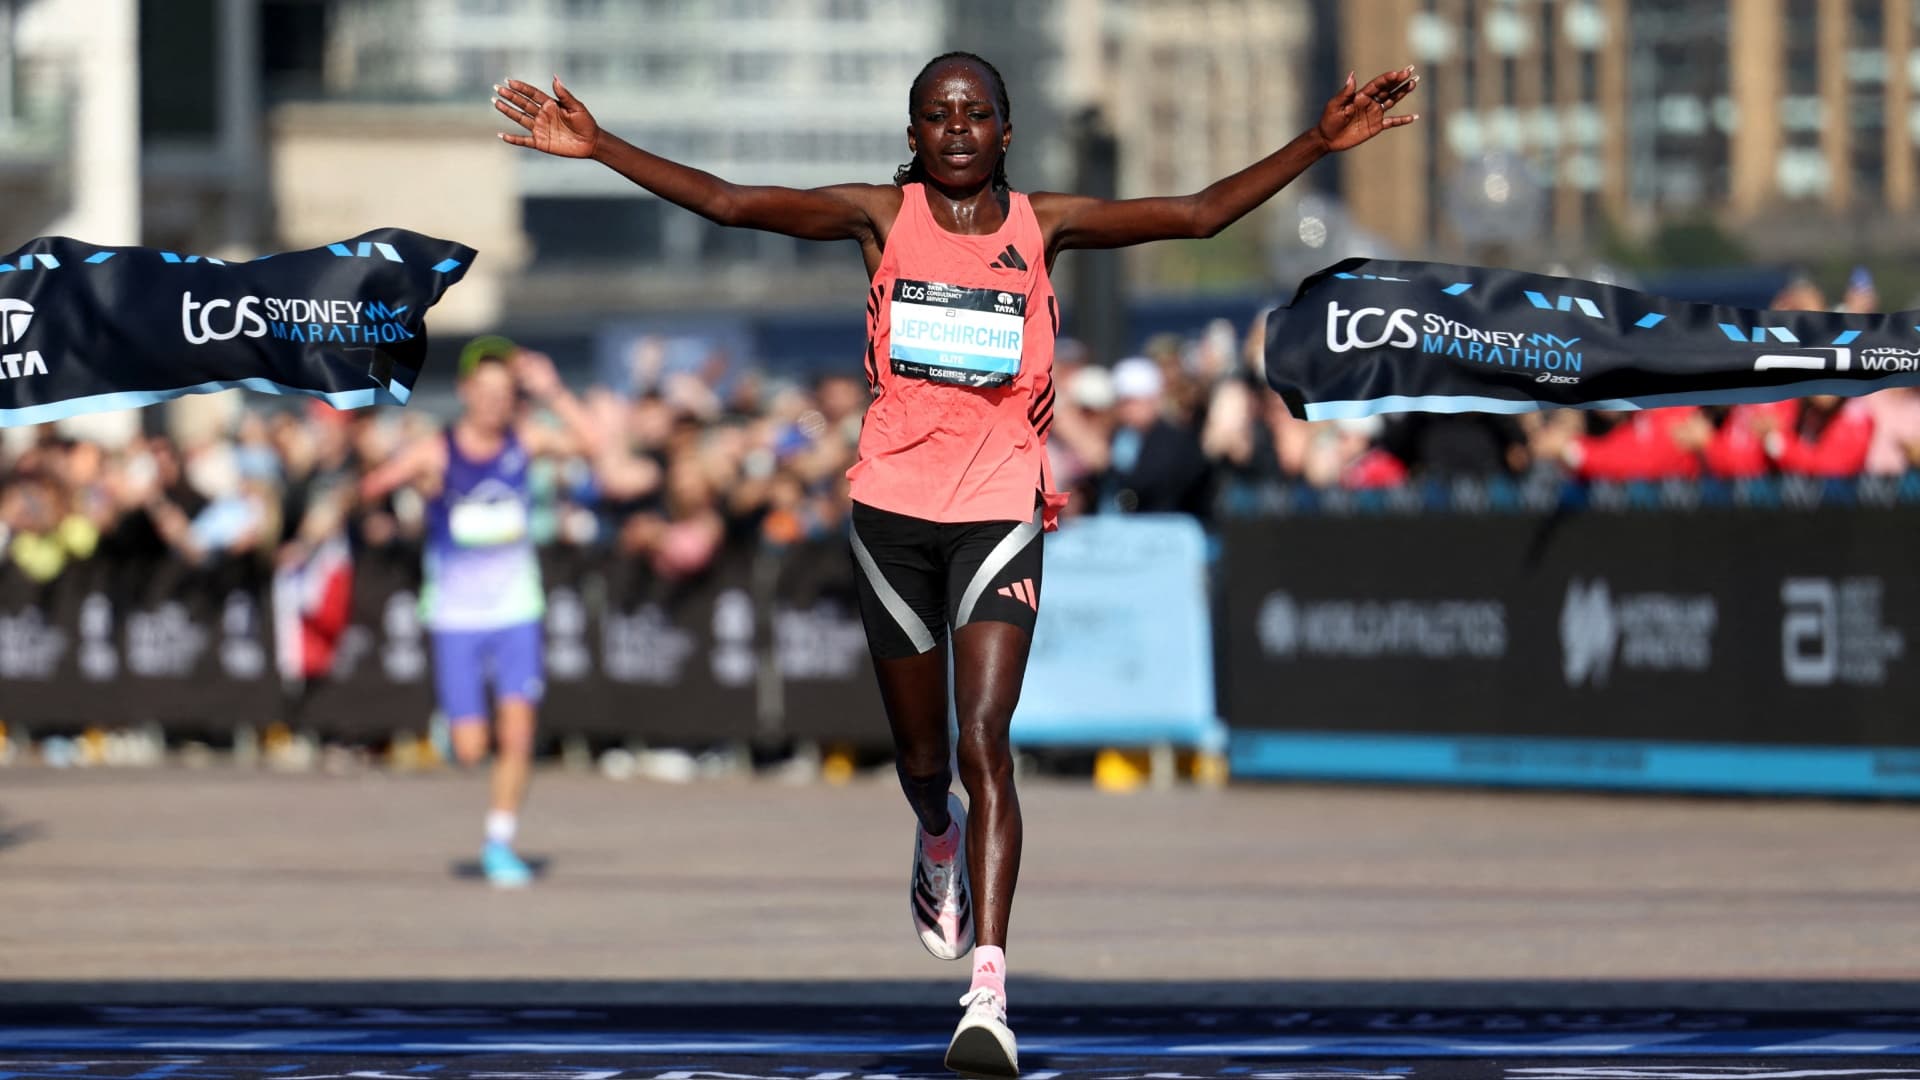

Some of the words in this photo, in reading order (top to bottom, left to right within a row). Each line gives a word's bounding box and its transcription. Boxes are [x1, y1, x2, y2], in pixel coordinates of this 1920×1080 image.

[902, 282, 925, 300] tcs
[182, 291, 268, 345] tcs
[265, 297, 363, 324] SYDNEY
[993, 304, 1016, 314] TATA
[271, 321, 416, 343] MARATHON
[895, 319, 1021, 351] JEPCHIRCHIR
[1326, 300, 1419, 353] tcs
[1422, 313, 1526, 348] SYDNEY
[1422, 335, 1583, 372] MARATHON
